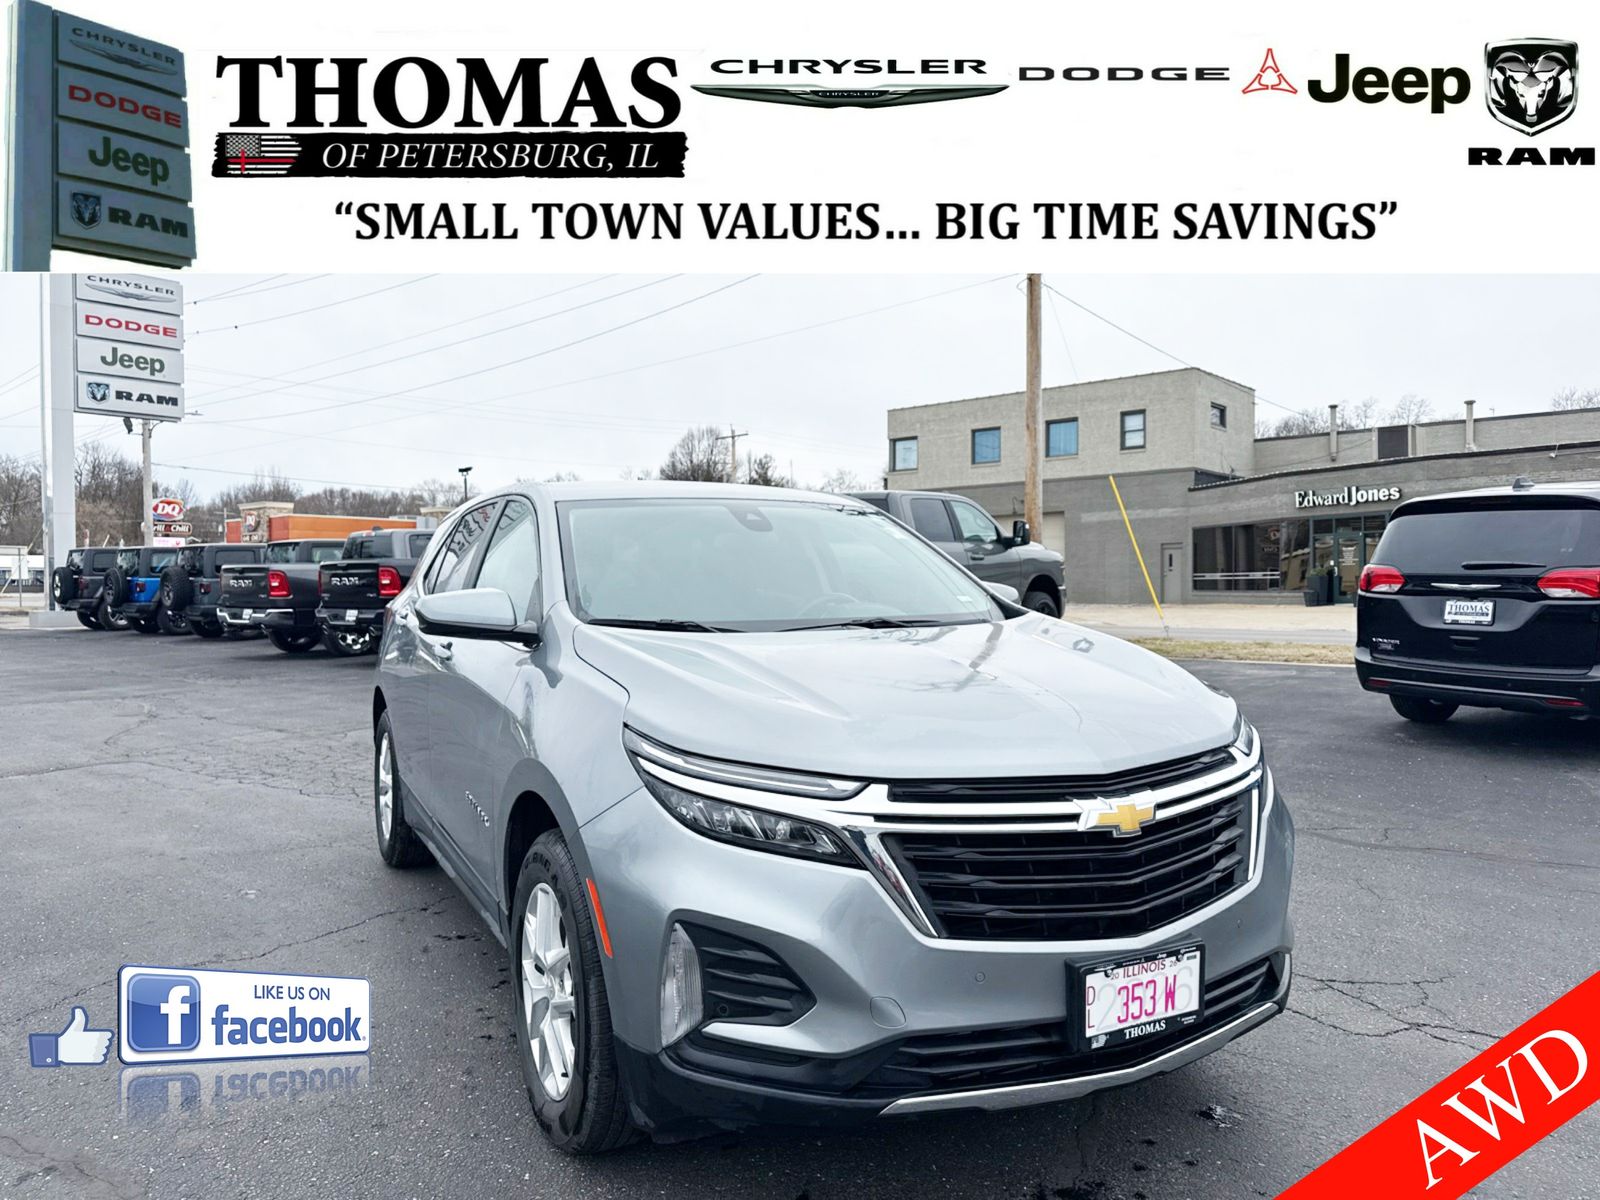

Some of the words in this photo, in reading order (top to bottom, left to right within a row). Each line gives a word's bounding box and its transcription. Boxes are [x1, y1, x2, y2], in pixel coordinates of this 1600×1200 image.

[87, 275, 175, 296] CHRYSLER
[85, 314, 177, 338] DODGE
[100, 347, 165, 376] Jeep
[115, 390, 178, 406] RAM
[1295, 488, 1349, 508] Edward
[1350, 486, 1401, 505] Jones
[157, 503, 180, 516] DQ
[1123, 959, 1166, 979] ILLINOIS
[1117, 978, 1157, 1024] 353
[1164, 975, 1177, 1013] W
[1124, 1020, 1166, 1039] THOMAS
